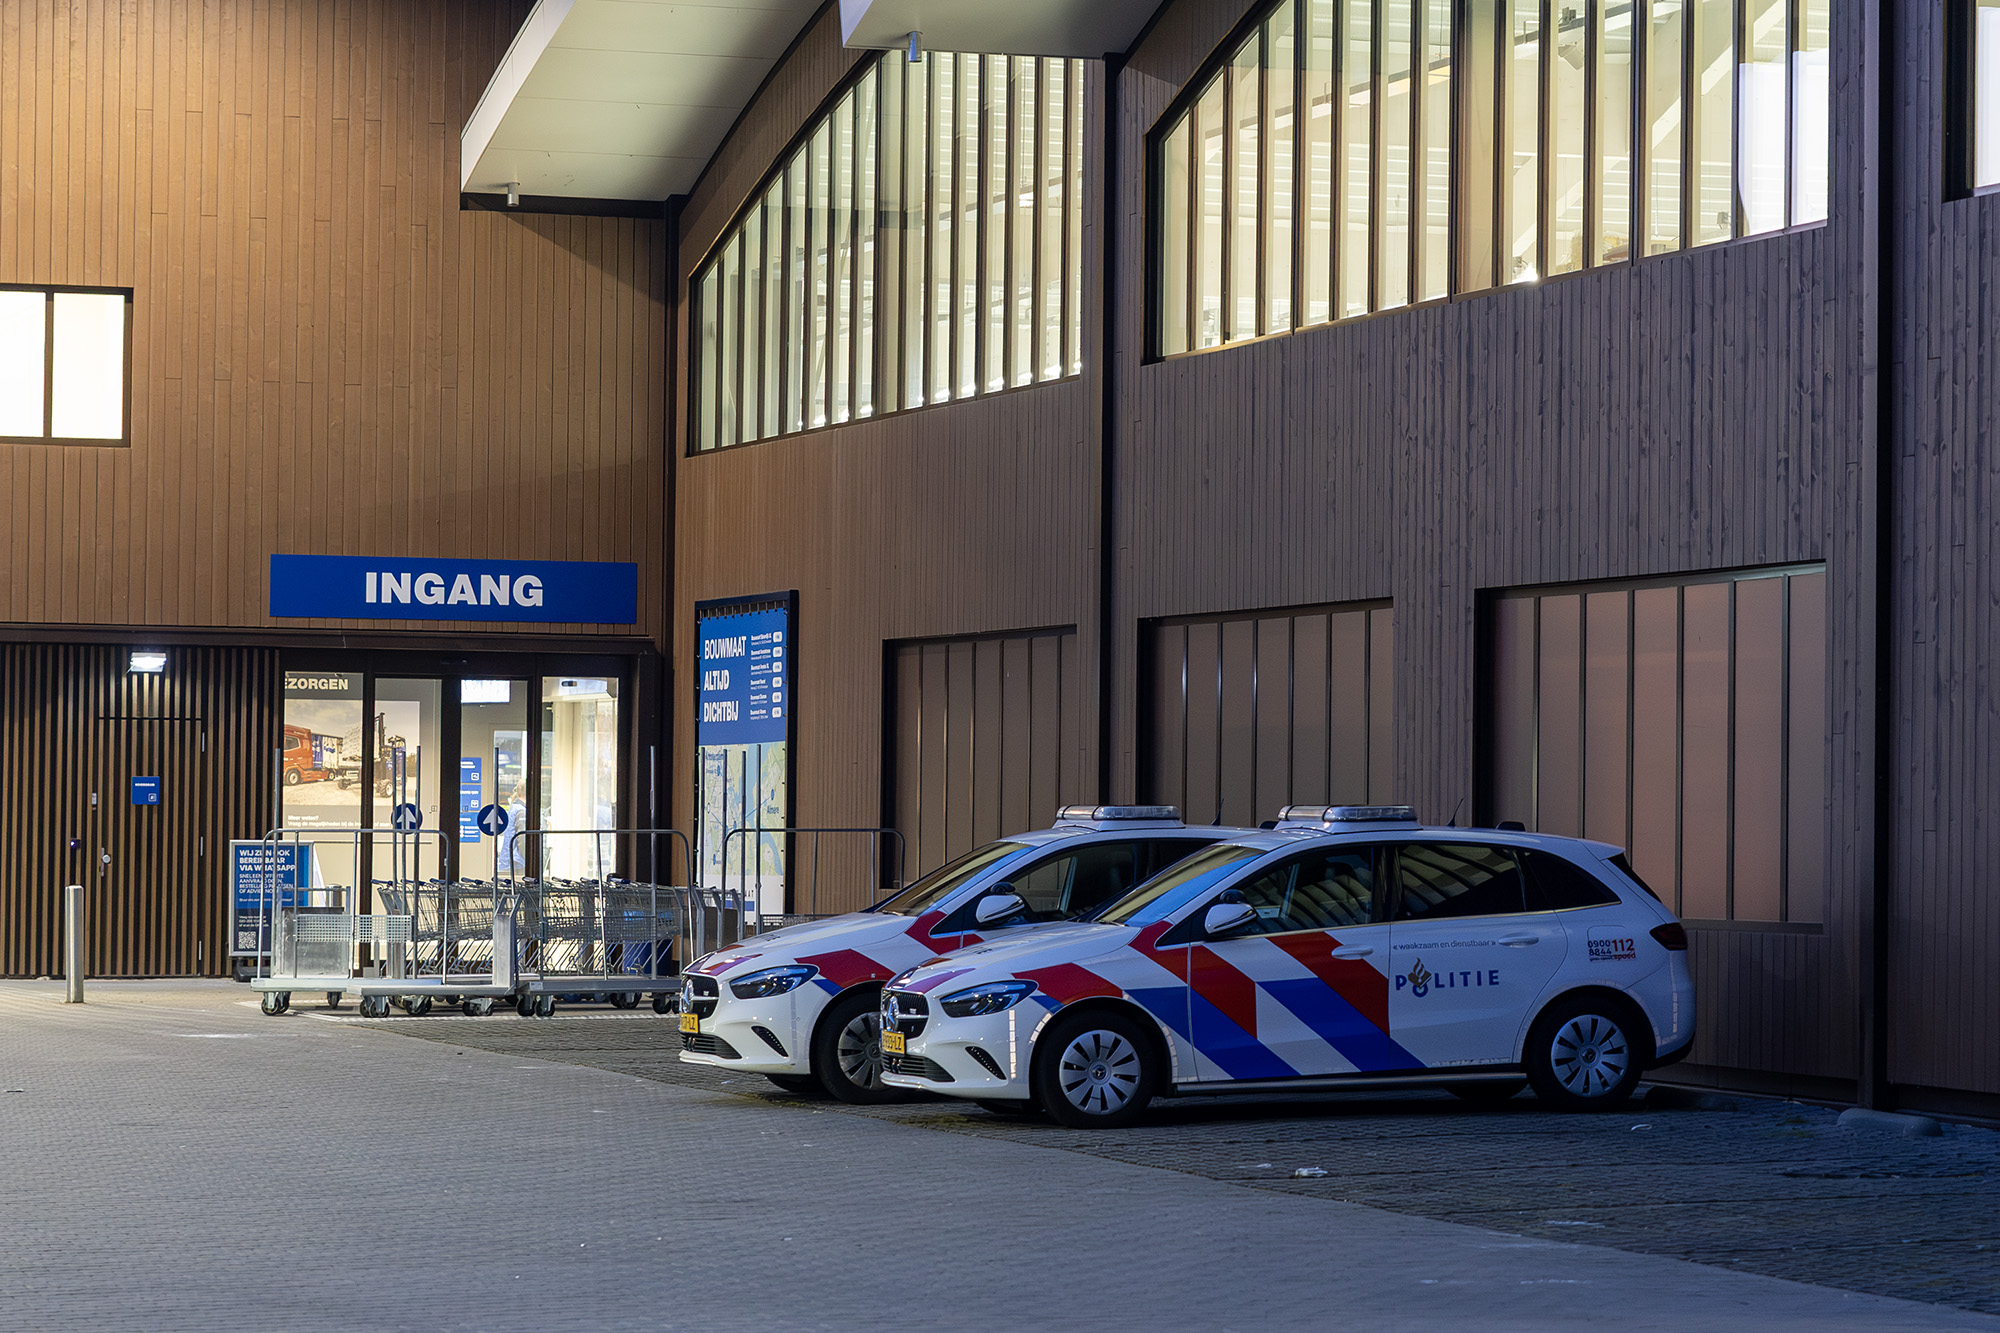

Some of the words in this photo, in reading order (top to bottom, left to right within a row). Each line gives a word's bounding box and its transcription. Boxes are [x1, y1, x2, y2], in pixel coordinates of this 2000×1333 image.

[365, 572, 543, 607] INGANG
[704, 636, 747, 660] BOUWMAAT
[285, 678, 348, 690] ZORGEN
[704, 669, 730, 691] ALTIJD
[704, 700, 739, 723] DICHTBIJ
[239, 849, 254, 857] WIJ
[254, 849, 272, 857] ZIN
[1398, 941, 1439, 950] waakzaam
[1440, 941, 1450, 949] en
[1451, 939, 1490, 948] dienstbaar
[1587, 939, 1611, 948] 0900
[1611, 938, 1635, 952] 112
[1588, 947, 1611, 956] 8844
[1395, 969, 1500, 998] POLITIE
